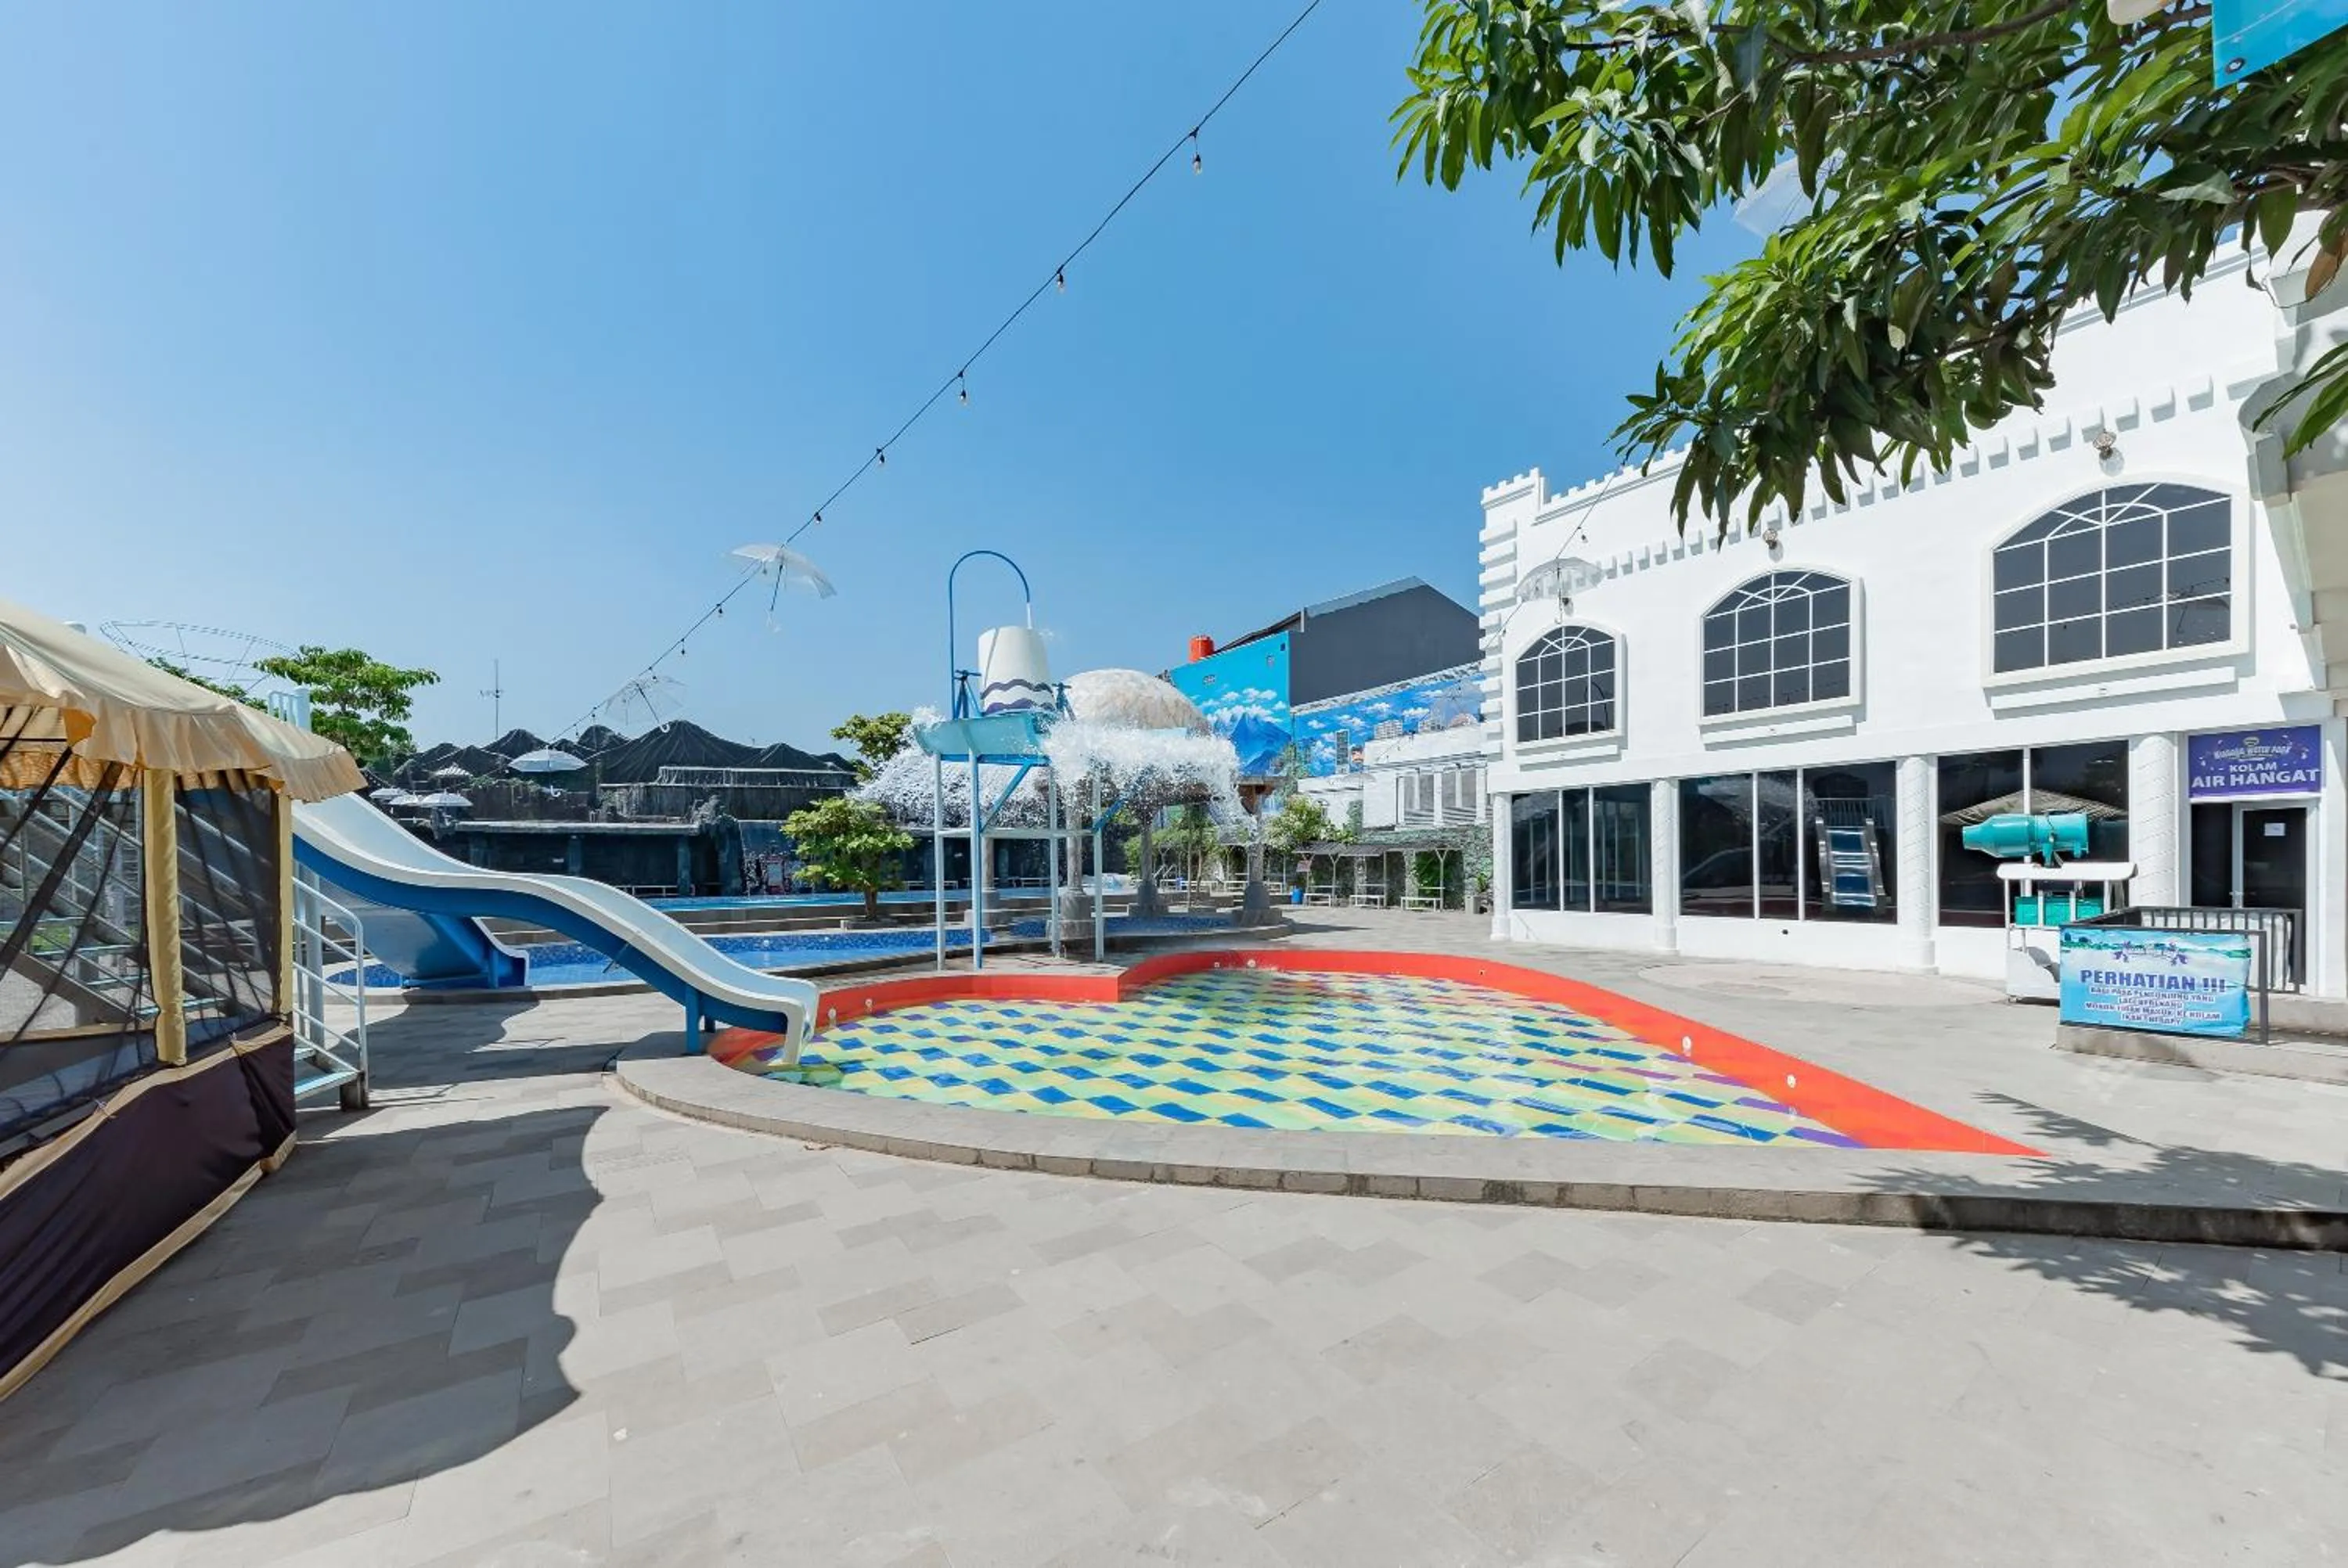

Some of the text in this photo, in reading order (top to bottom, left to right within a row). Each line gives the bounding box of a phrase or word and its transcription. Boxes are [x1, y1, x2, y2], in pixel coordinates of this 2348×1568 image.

[2229, 761, 2278, 773] KOLAM
[2191, 769, 2320, 789] AIR HANGAT
[2080, 969, 2226, 992] PERHATIAN !!!
